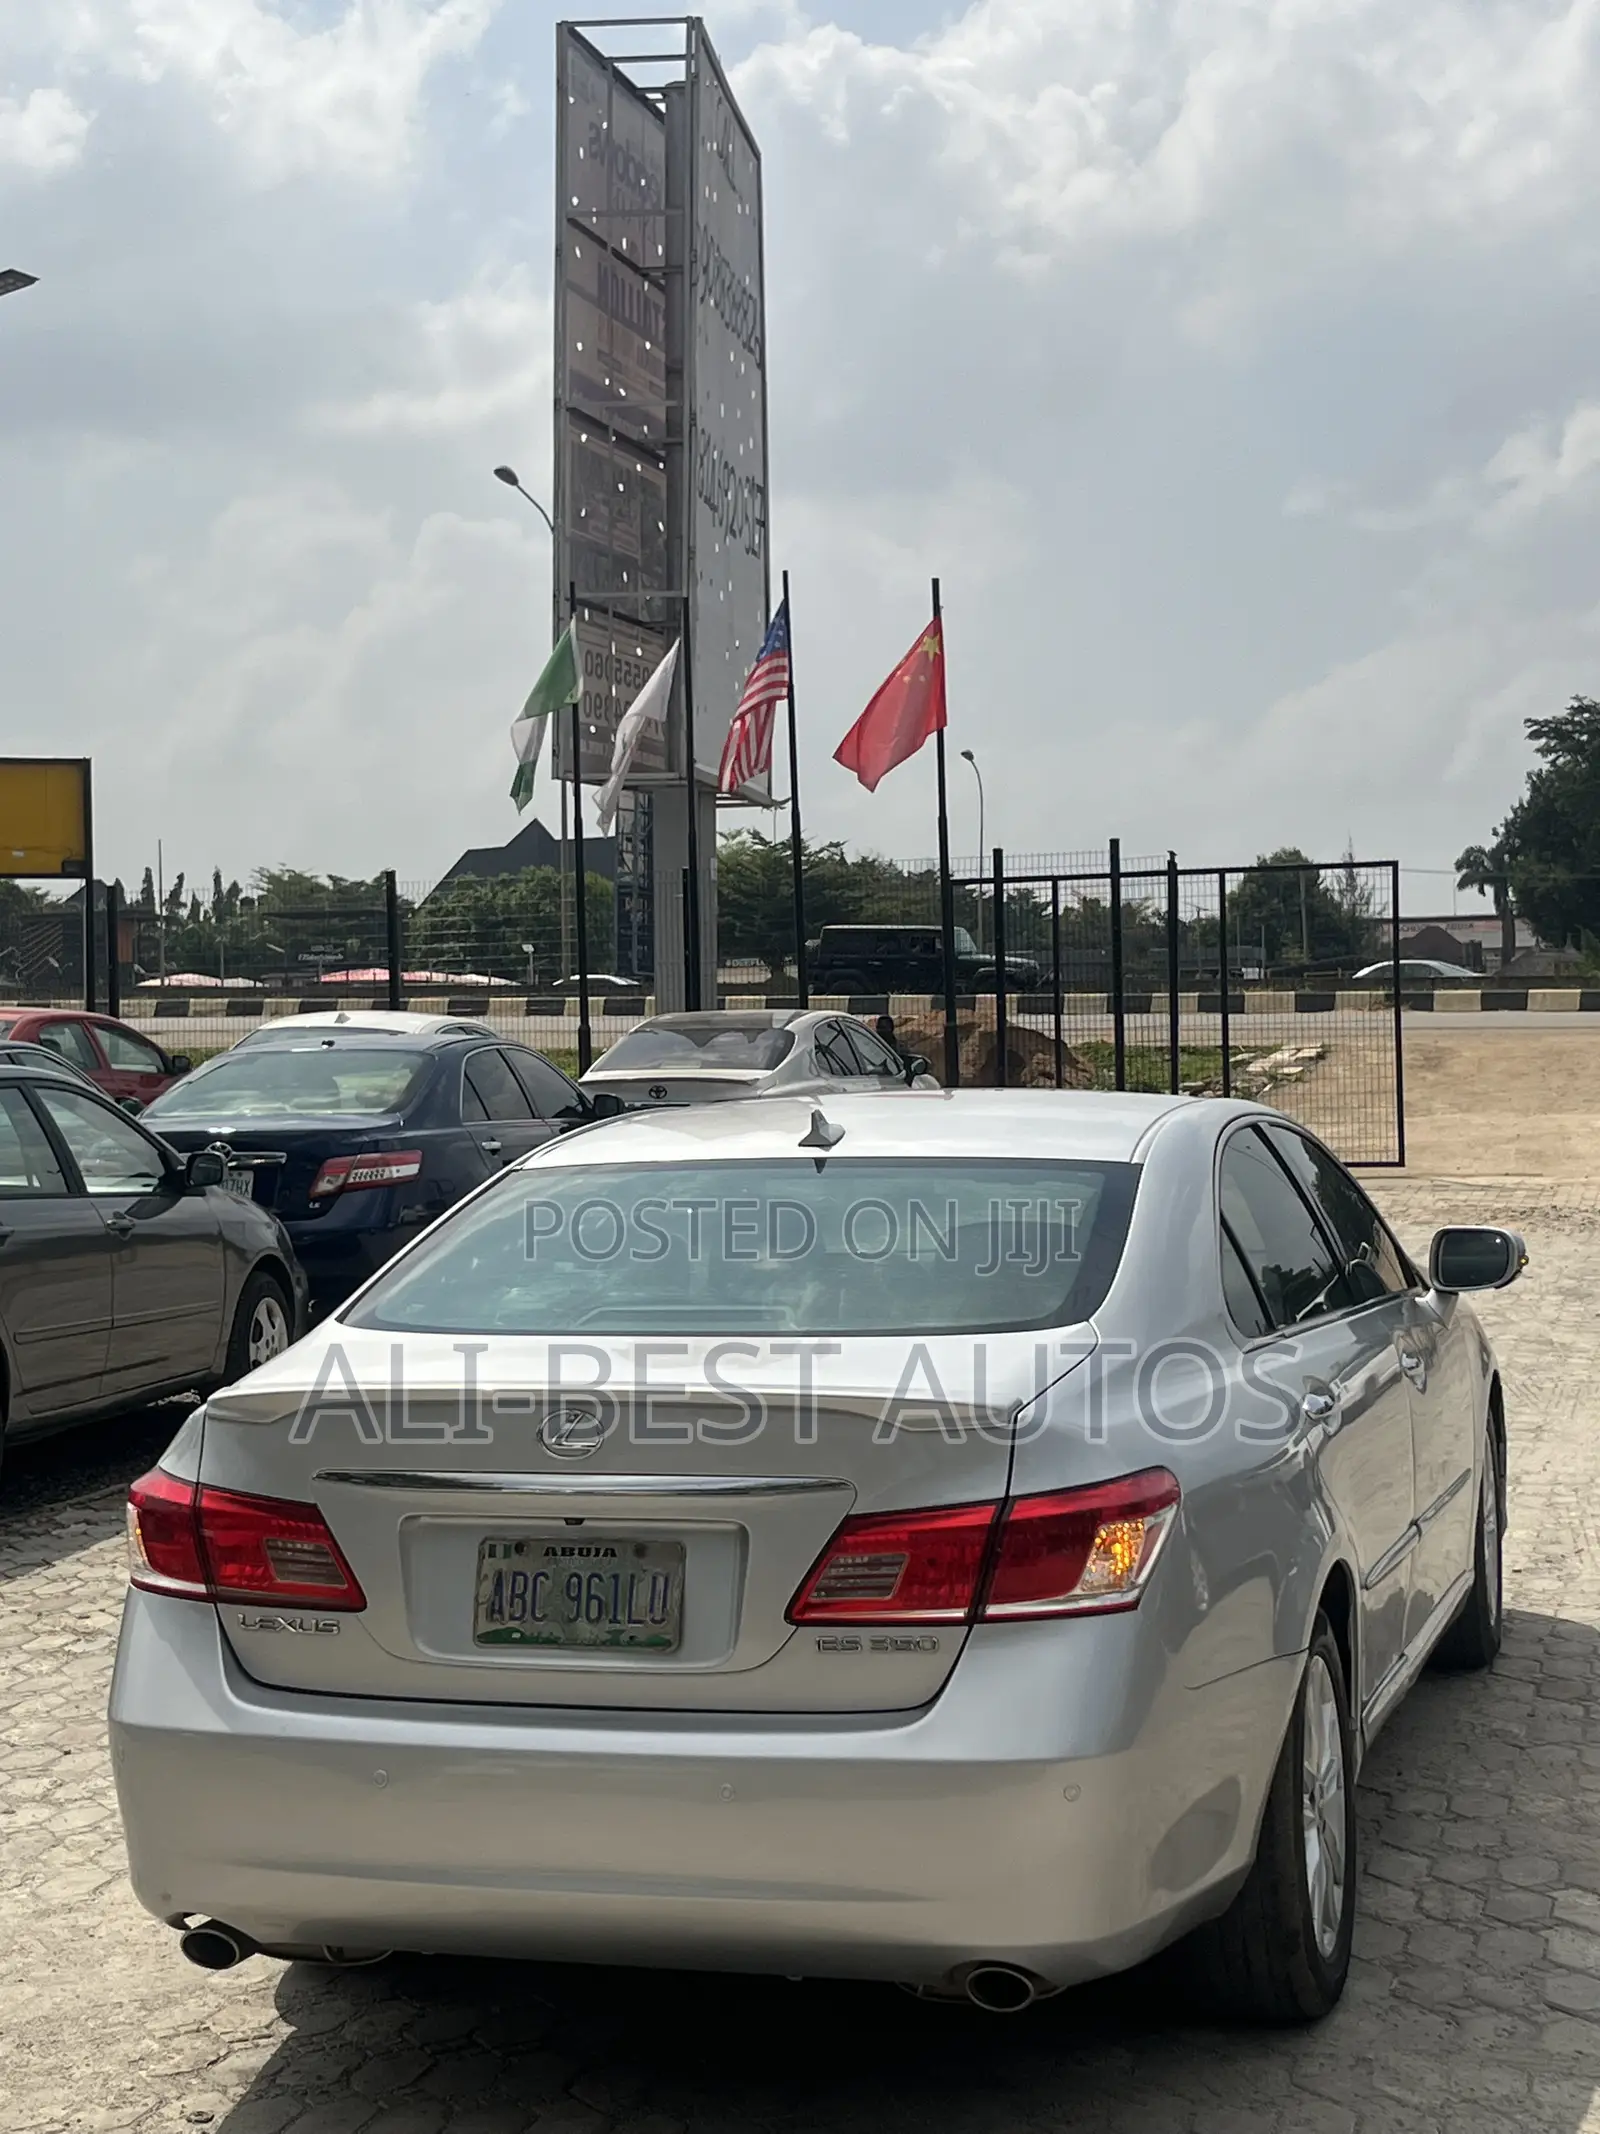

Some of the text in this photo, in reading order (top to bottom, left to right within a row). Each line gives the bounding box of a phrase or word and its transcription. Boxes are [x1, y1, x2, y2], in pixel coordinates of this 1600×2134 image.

[543, 1546, 618, 1558] ABUJA
[488, 1568, 550, 1623] ABC
[237, 1612, 341, 1636] LEXUS
[815, 1635, 940, 1655] ES 350
